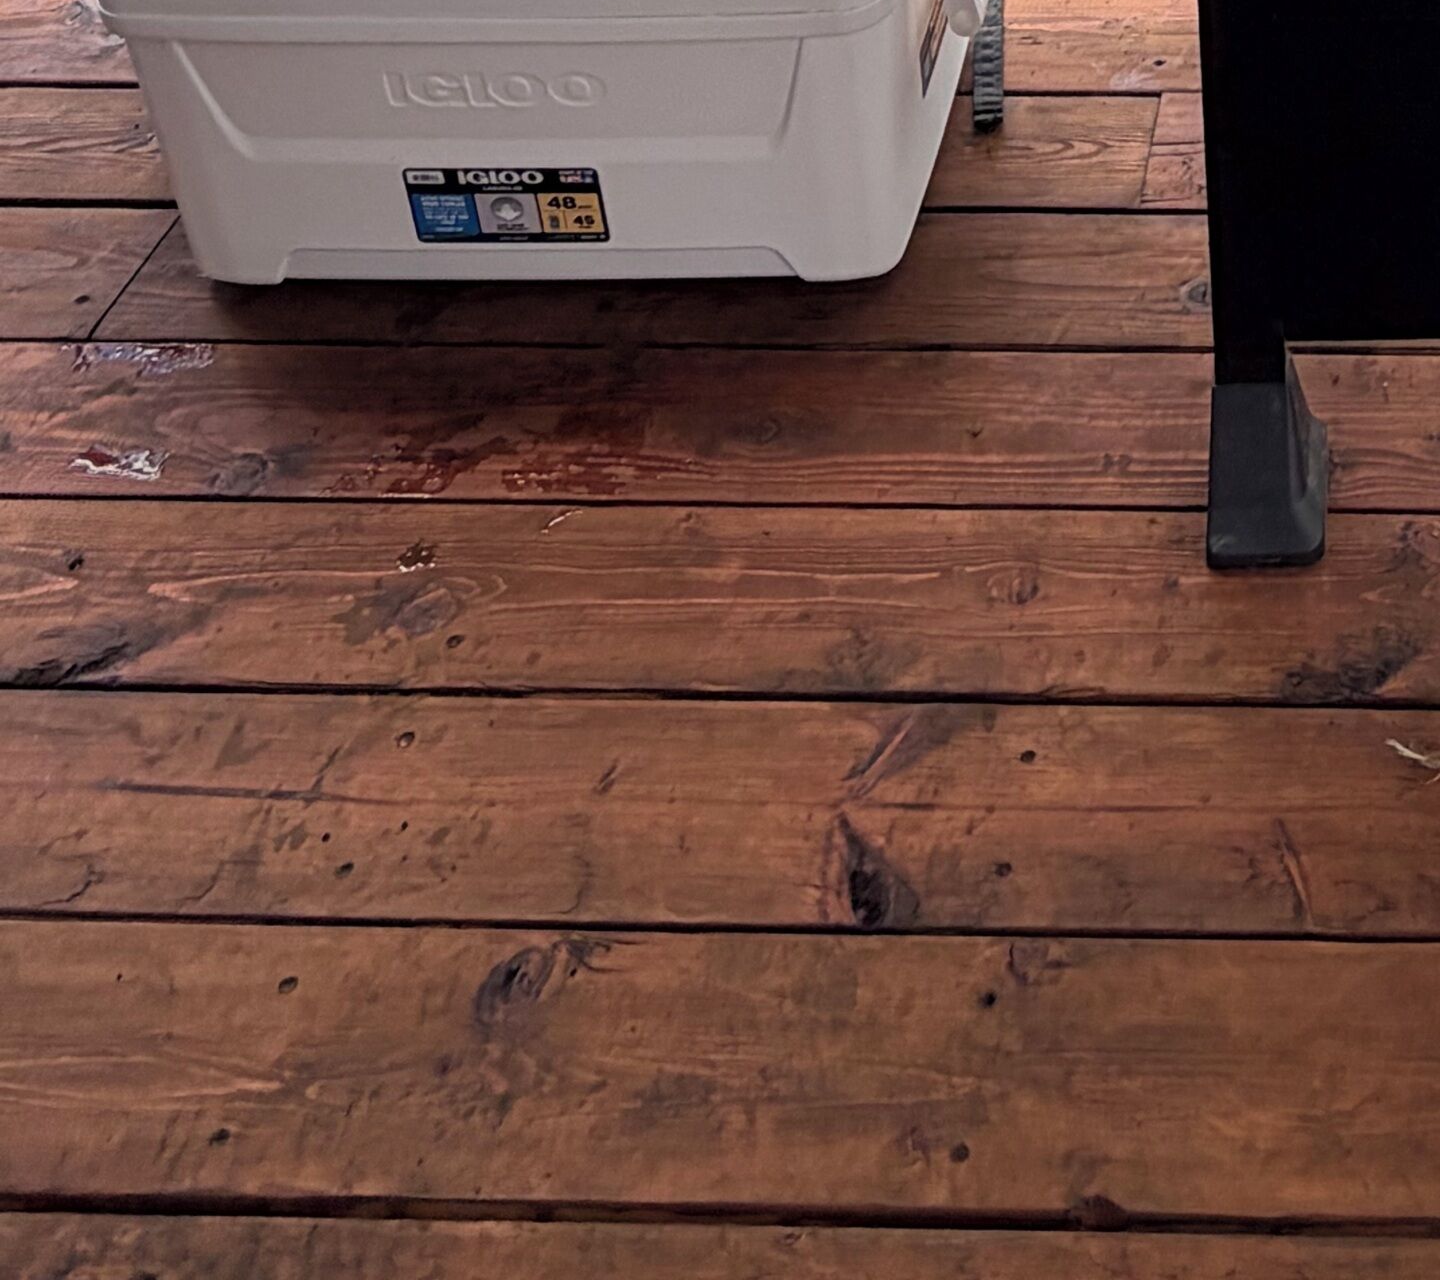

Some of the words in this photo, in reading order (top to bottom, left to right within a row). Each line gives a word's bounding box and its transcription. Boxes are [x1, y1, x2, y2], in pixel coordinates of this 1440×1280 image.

[383, 70, 608, 107] IGLOO
[457, 170, 544, 185] IGLOO
[547, 196, 577, 210] 48
